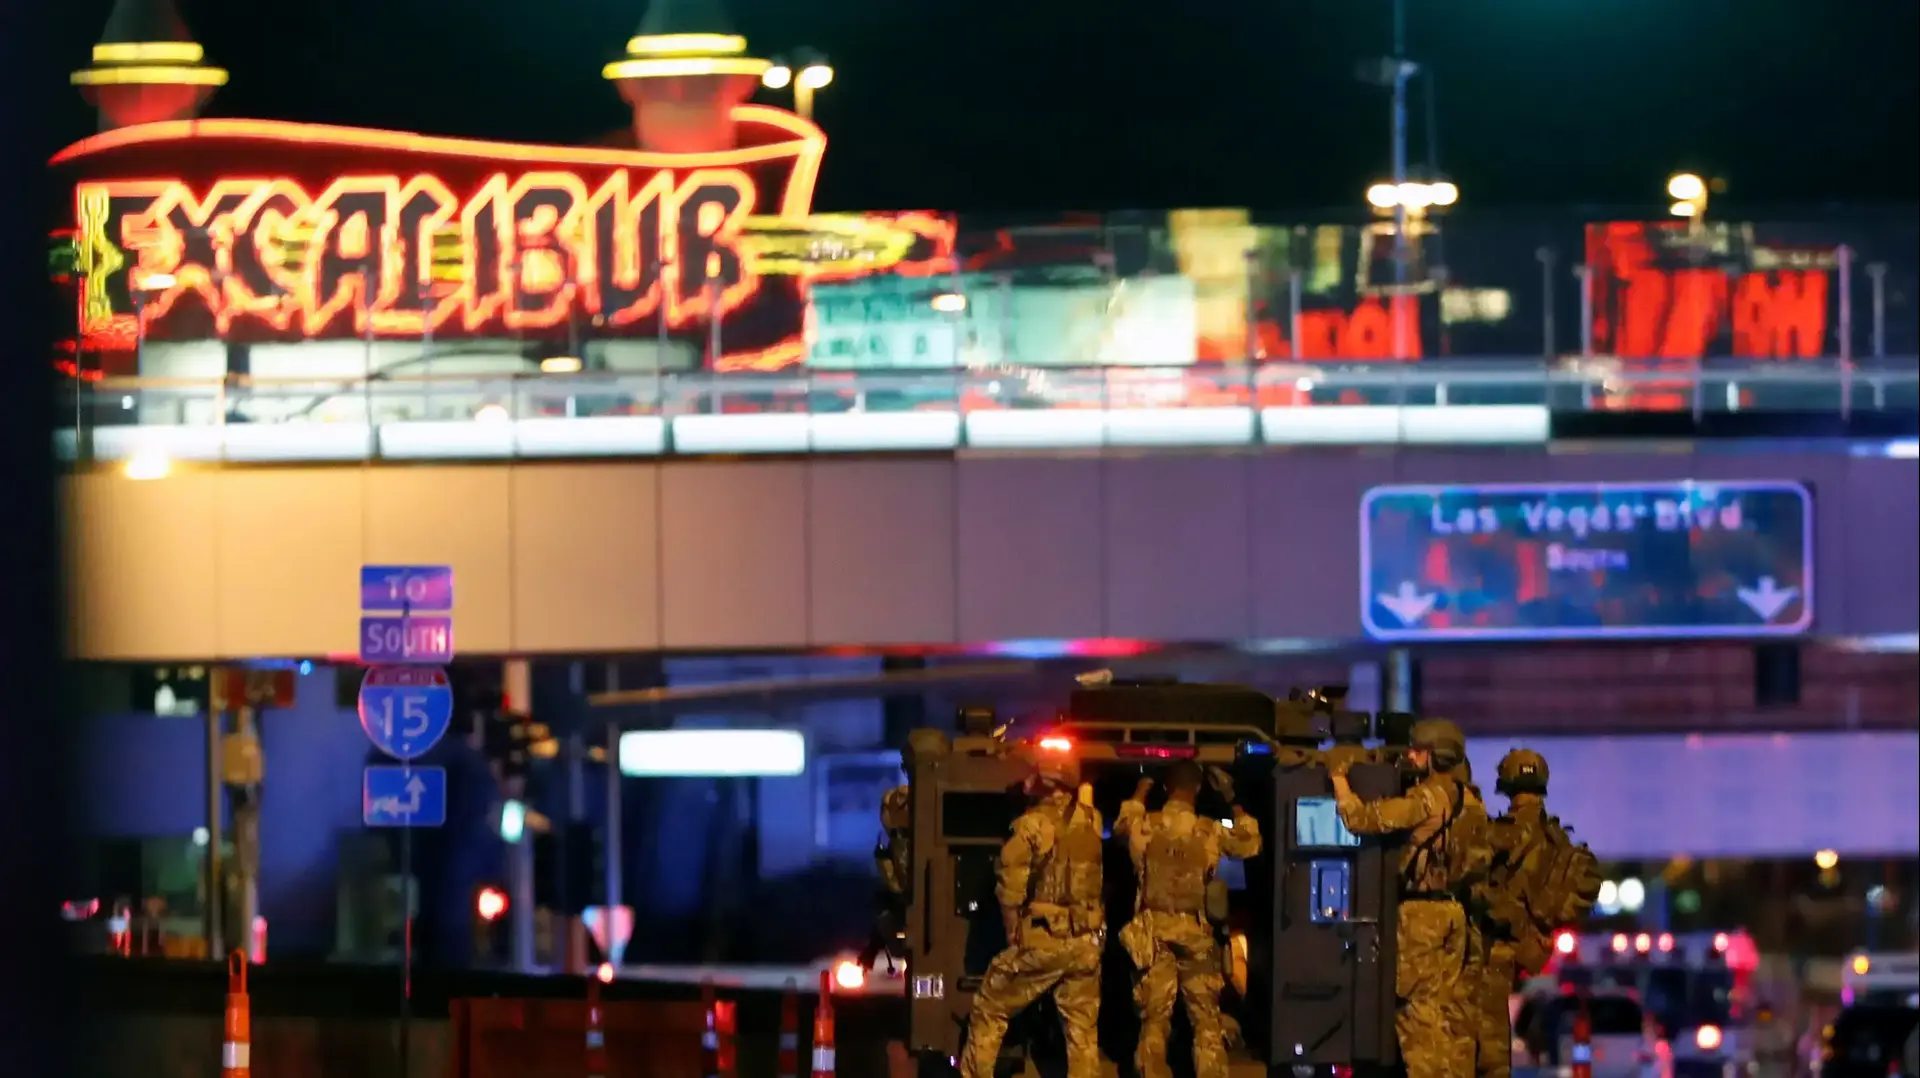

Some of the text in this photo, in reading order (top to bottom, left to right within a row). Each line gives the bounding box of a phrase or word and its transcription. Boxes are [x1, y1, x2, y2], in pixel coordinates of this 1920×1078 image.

[77, 170, 759, 336] EXCALIBUR
[1430, 502, 1497, 534] Las
[1522, 501, 1635, 540] Vegas
[384, 574, 428, 601] TO
[366, 622, 447, 658] SOUTH
[381, 695, 429, 739] 15
